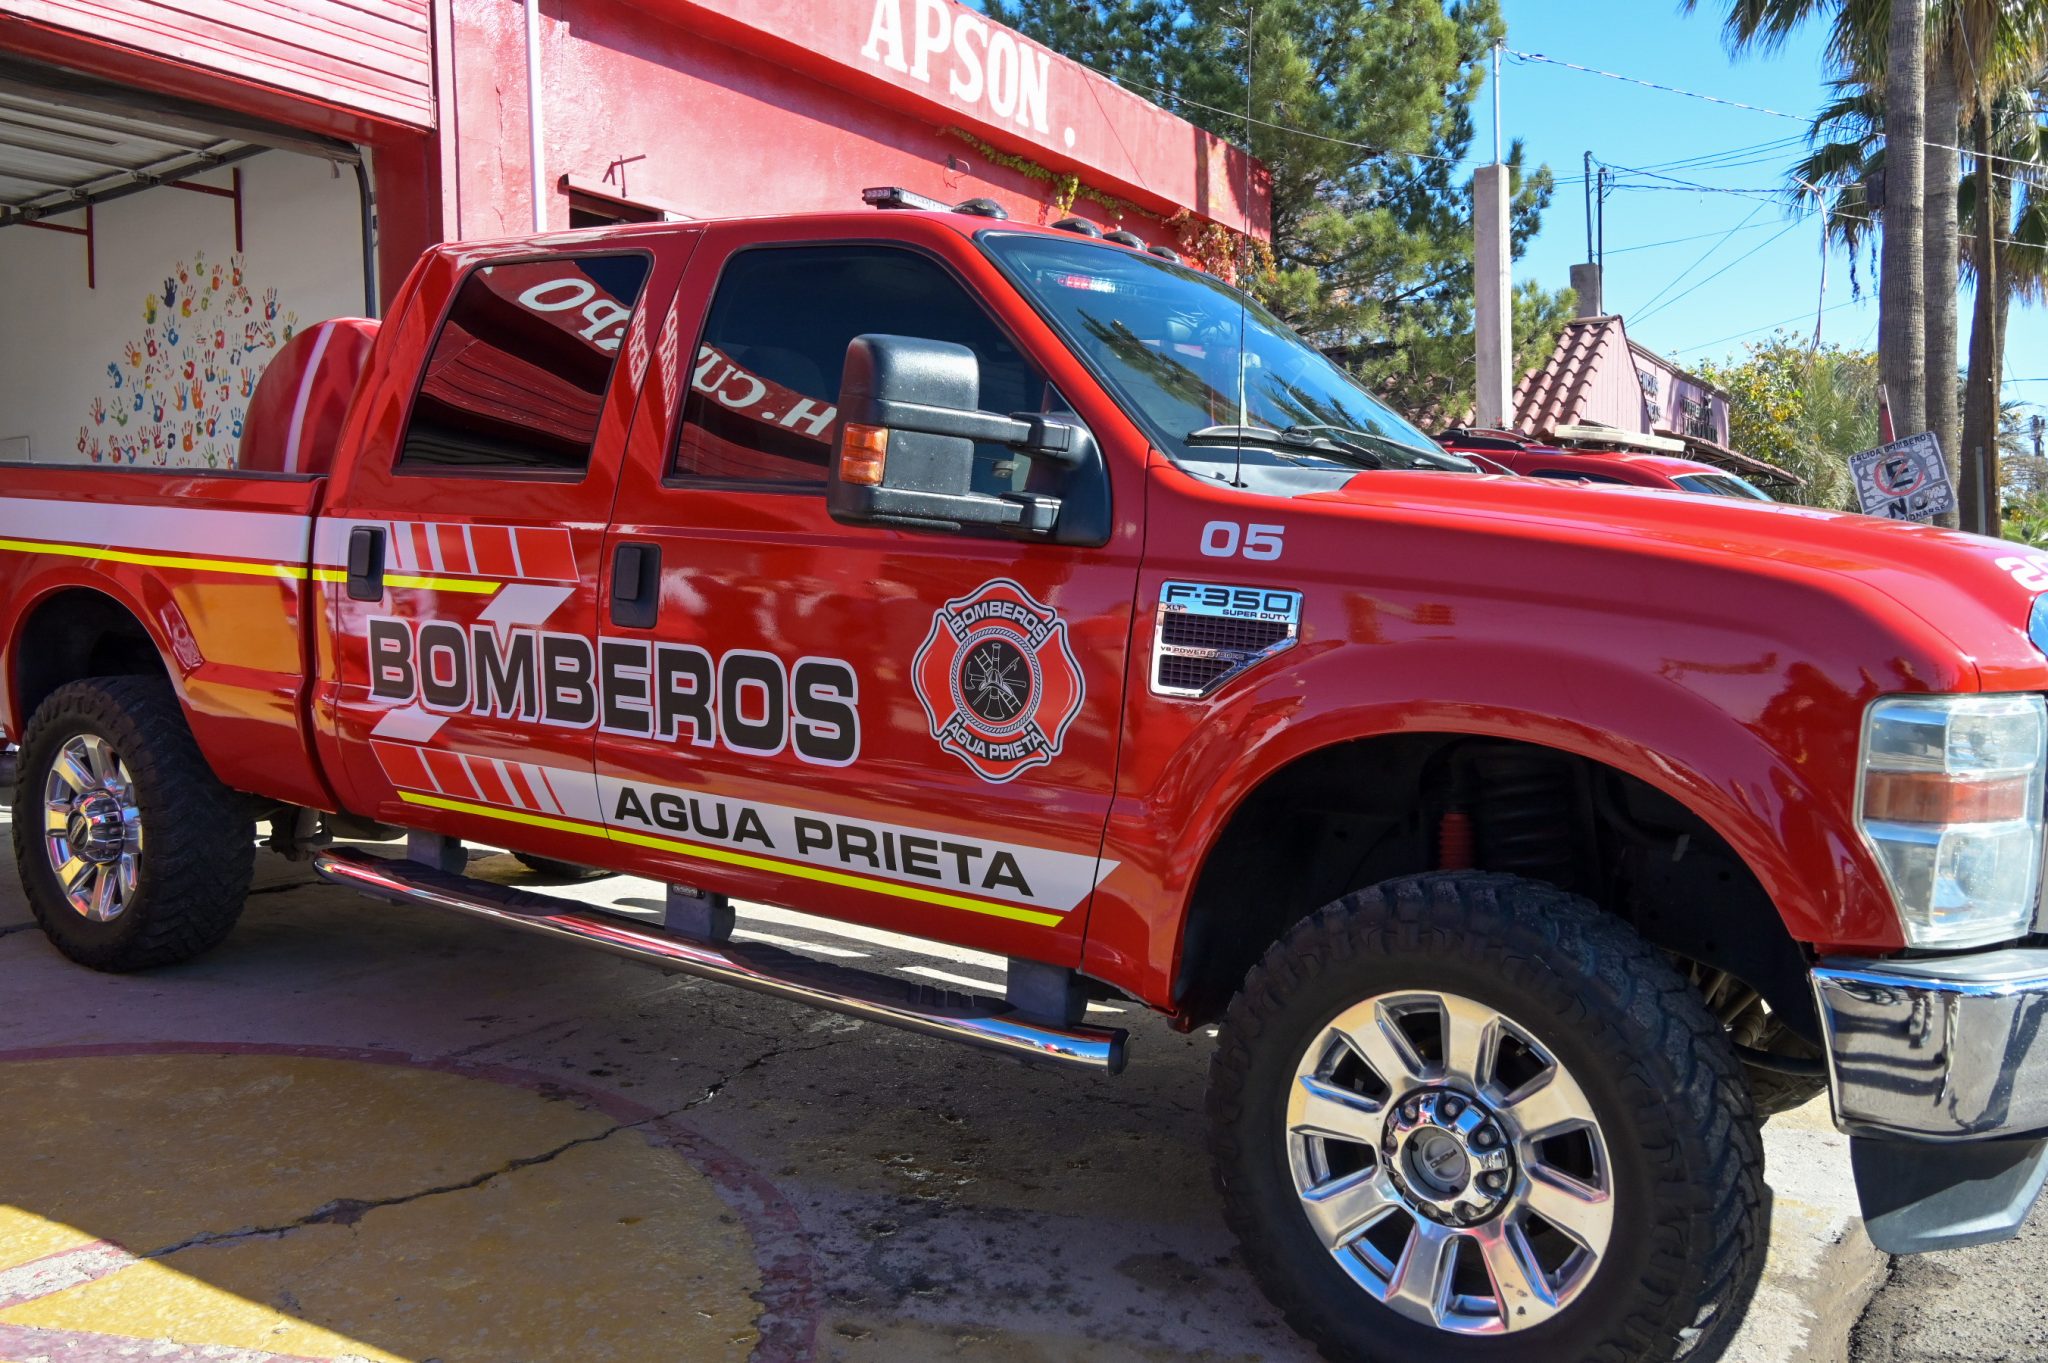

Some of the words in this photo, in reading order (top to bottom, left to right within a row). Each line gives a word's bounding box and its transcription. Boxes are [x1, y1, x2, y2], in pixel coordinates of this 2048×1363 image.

[1850, 450, 1881, 463] SALIDA
[1884, 433, 1932, 453] BOMBEROS
[1200, 520, 1285, 561] 05
[950, 601, 1048, 645] BOMBEROS
[1222, 608, 1258, 618] SUPER
[1259, 611, 1290, 621] DUTY
[367, 614, 861, 768] BOMBEROS
[948, 721, 987, 759] AGUA
[989, 732, 1044, 760] PRIETA
[614, 786, 776, 849] AGUA
[794, 815, 1034, 898] PRIETA
